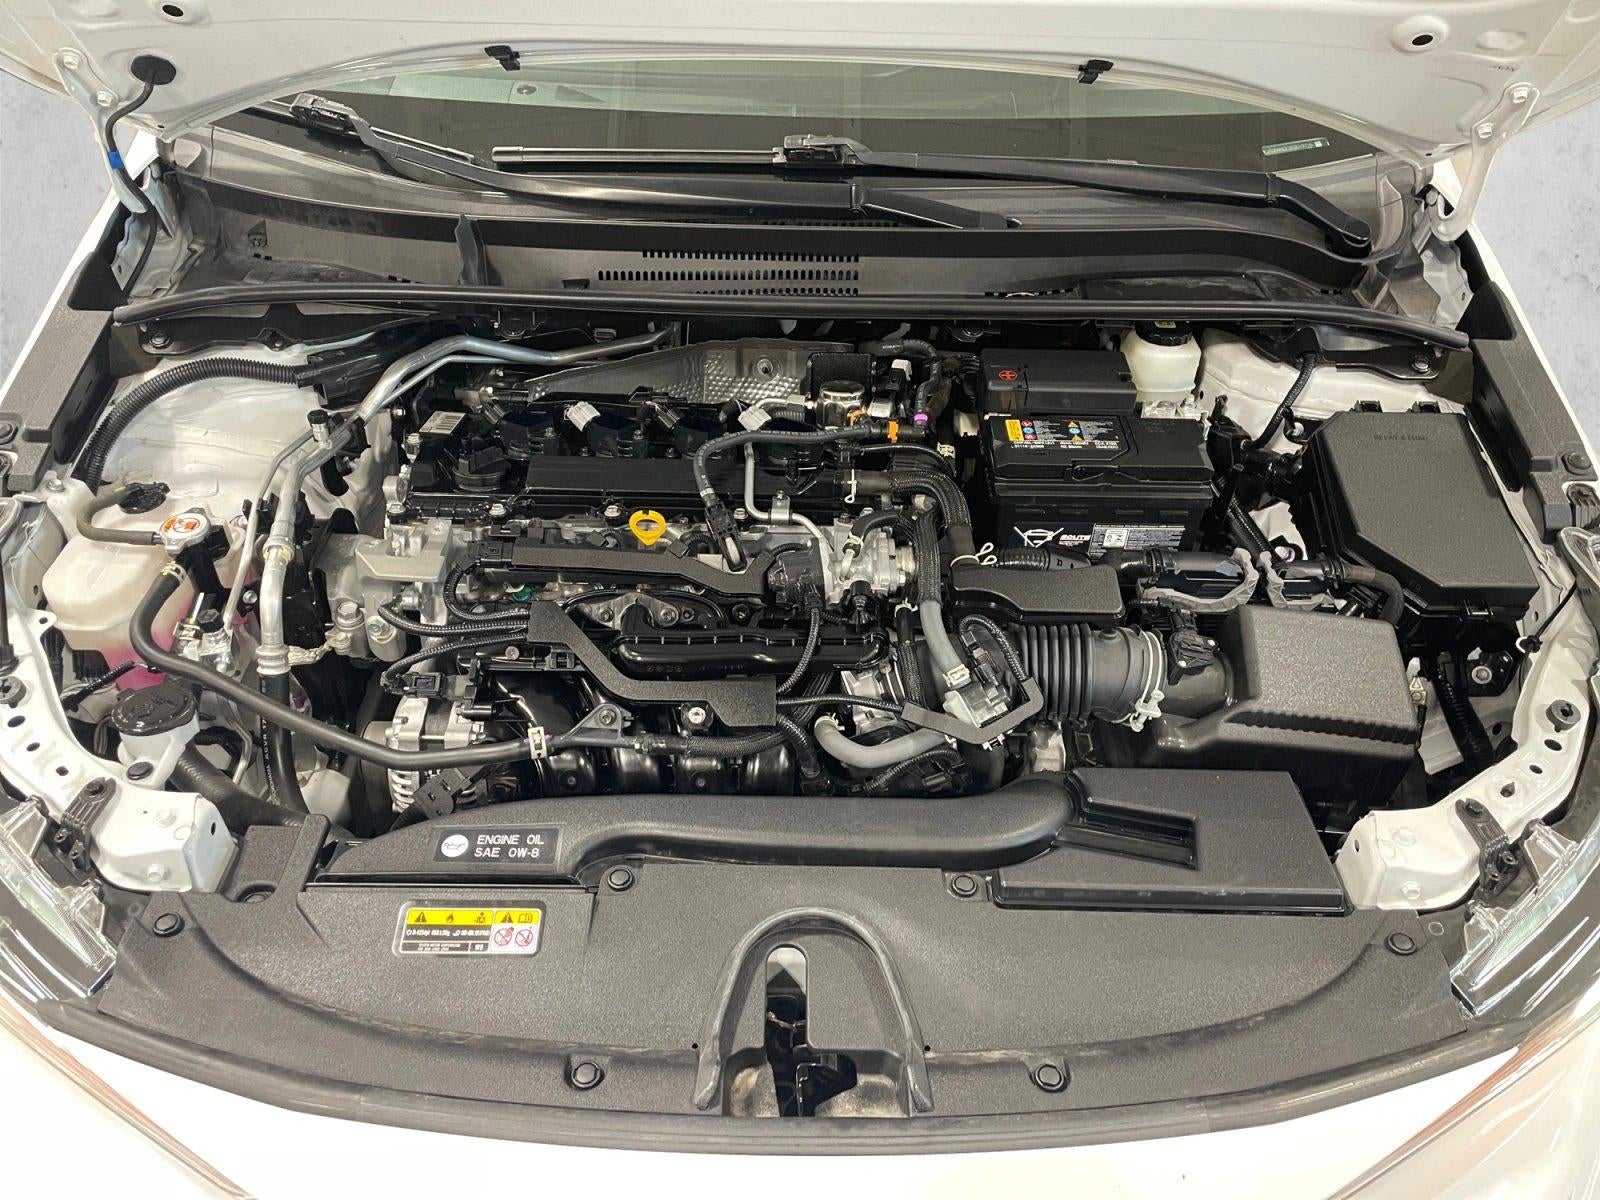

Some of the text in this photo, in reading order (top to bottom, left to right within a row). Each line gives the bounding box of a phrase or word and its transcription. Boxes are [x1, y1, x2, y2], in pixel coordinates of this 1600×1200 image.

[476, 834, 545, 845] ENGINE OIL
[473, 847, 501, 858] SAE
